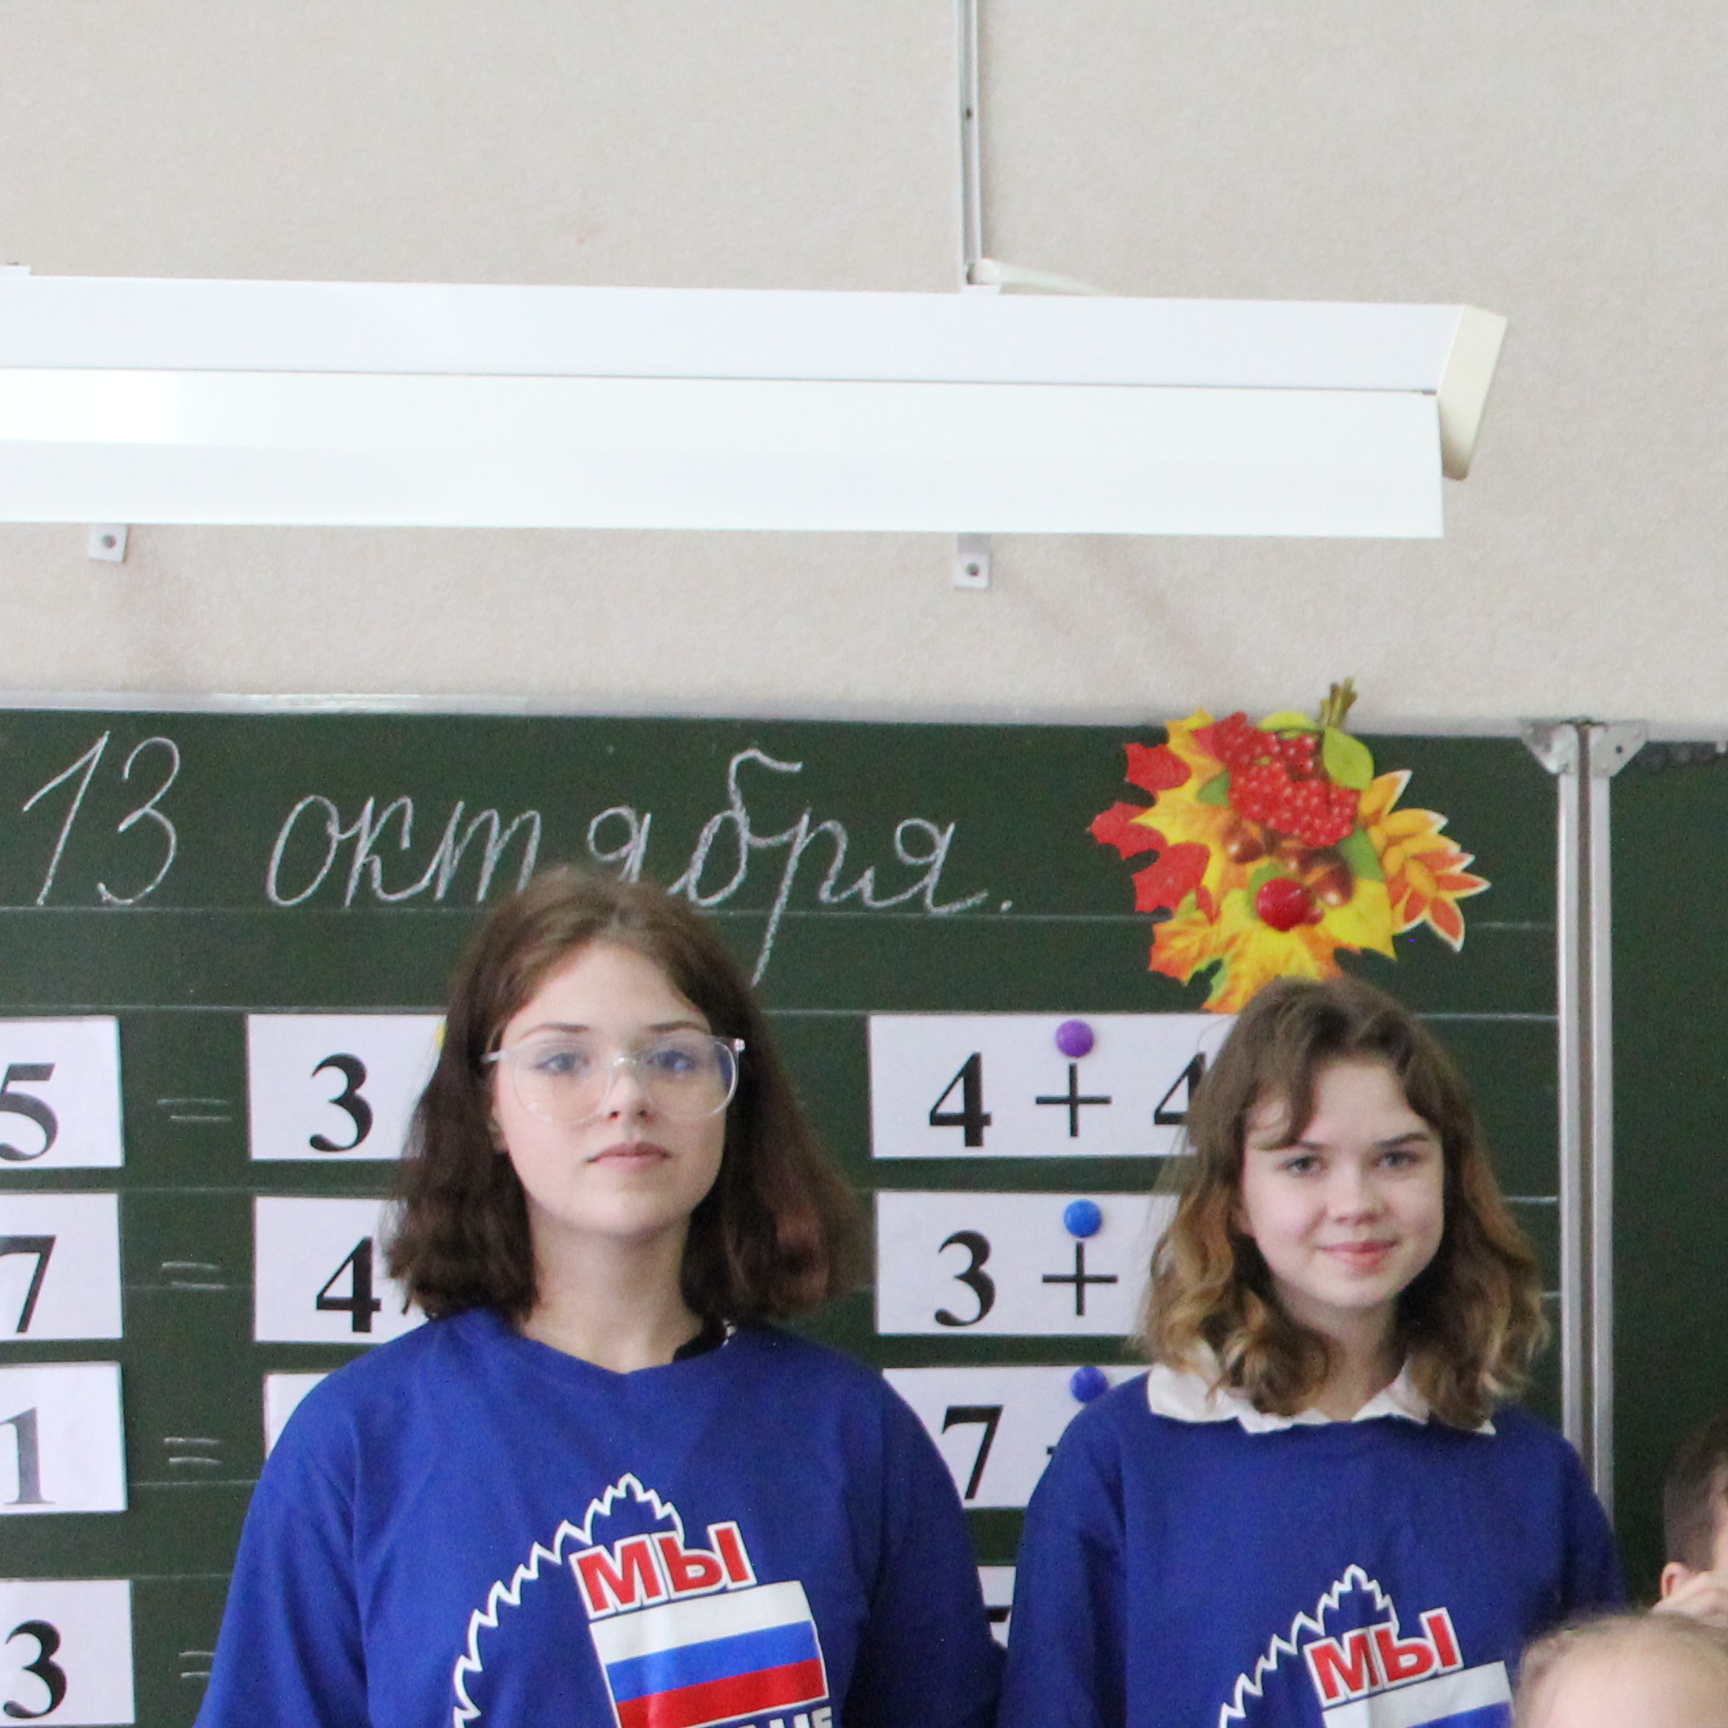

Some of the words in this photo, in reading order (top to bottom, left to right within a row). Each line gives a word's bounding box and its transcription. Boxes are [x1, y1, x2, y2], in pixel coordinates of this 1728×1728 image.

[23, 730, 182, 908] 13
[0, 1063, 58, 1161] 5
[308, 1053, 373, 1153] 3
[0, 1235, 56, 1333] 7
[316, 1236, 381, 1332] 4
[0, 1406, 56, 1505] 1
[941, 1405, 1003, 1500] 7
[573, 1523, 754, 1616] МЫ
[4, 1620, 67, 1719] 3
[1305, 1609, 1462, 1706] МЫ
